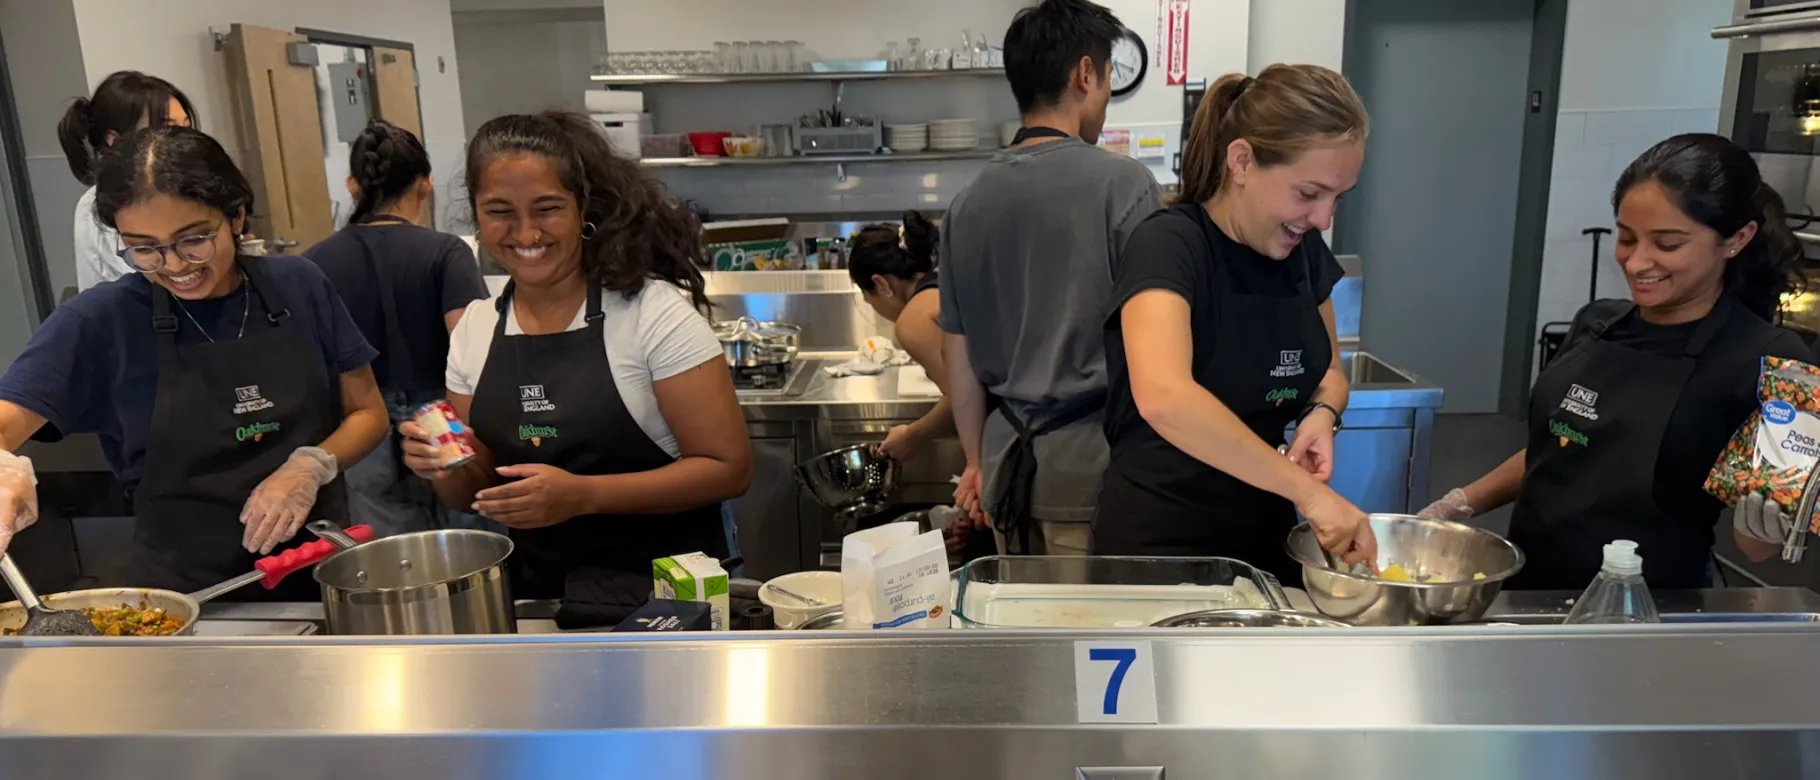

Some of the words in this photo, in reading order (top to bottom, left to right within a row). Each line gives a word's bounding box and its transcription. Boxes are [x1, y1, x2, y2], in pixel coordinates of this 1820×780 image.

[237, 387, 259, 399] UNE
[520, 387, 542, 398] UNE
[1570, 386, 1595, 403] UNE
[524, 403, 555, 412] ENGLAND
[1765, 403, 1791, 417] Great
[1787, 429, 1815, 446] Peas
[1089, 648, 1136, 714] 7
